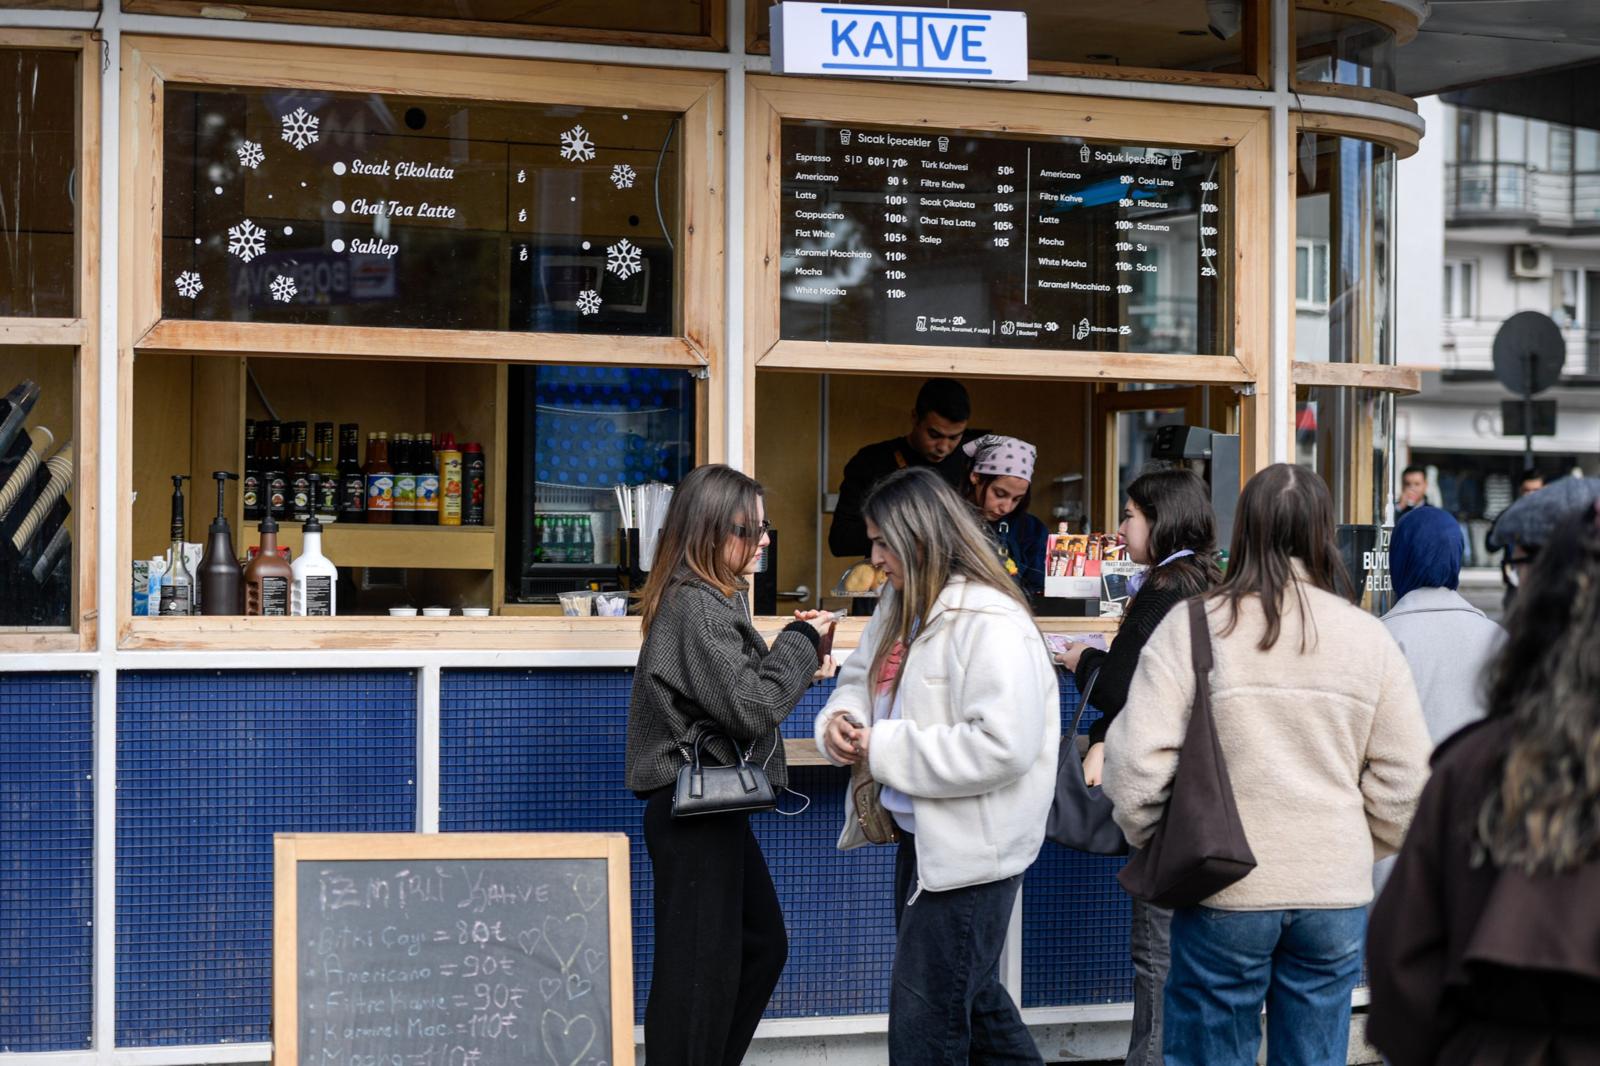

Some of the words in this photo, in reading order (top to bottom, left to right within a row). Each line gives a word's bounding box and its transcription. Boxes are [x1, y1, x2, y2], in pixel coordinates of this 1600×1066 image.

[831, 14, 988, 68] KAHVE
[857, 133, 885, 145] Sıcak
[887, 132, 932, 148] İçecekler
[795, 153, 832, 163] Espresso
[1094, 151, 1124, 165] Soğuk
[1125, 152, 1168, 167] İçecekler
[350, 159, 391, 176] Sıcak
[394, 161, 454, 180] Çikolata
[920, 160, 937, 169] Türk
[939, 161, 969, 171] Kahvesi
[795, 172, 839, 182] Americano
[1039, 169, 1081, 179] Americano
[920, 179, 940, 188] Filtre
[941, 180, 966, 190] Kahve
[1138, 177, 1156, 185] Cool
[1156, 178, 1175, 187] Lime
[795, 191, 817, 200] Latte
[1039, 192, 1059, 201] Filtre
[1060, 193, 1084, 203] Kahve
[350, 198, 384, 215] Chai
[387, 200, 414, 217] Tea
[416, 202, 456, 219] Latte
[919, 197, 942, 207] Sıcak
[943, 199, 976, 209] Çikolata
[1138, 199, 1169, 209] Hibiscus
[795, 209, 845, 221] Cappuccino
[1039, 215, 1060, 224] Latte
[919, 216, 939, 225] Chai
[940, 217, 955, 226] Tea
[955, 219, 977, 228] Latte
[1137, 222, 1170, 232] Satsuma
[795, 229, 811, 237] Flat
[812, 230, 836, 239] White
[919, 235, 942, 245] Salep
[993, 237, 1010, 247] 105
[1038, 237, 1065, 246] Mocha
[349, 238, 399, 260] Sahlep
[1137, 243, 1147, 252] Su
[795, 248, 828, 257] Karamel
[830, 249, 872, 259] Macchiato
[1038, 257, 1060, 266] White
[1061, 259, 1087, 268] Mocha
[1136, 263, 1158, 272] Soda
[795, 267, 823, 276] Mocha
[795, 286, 818, 295] White
[819, 288, 847, 296] Mocha
[1038, 280, 1070, 289] Karamel
[1071, 282, 1111, 292] Macchiato
[323, 953, 432, 985] Americano
